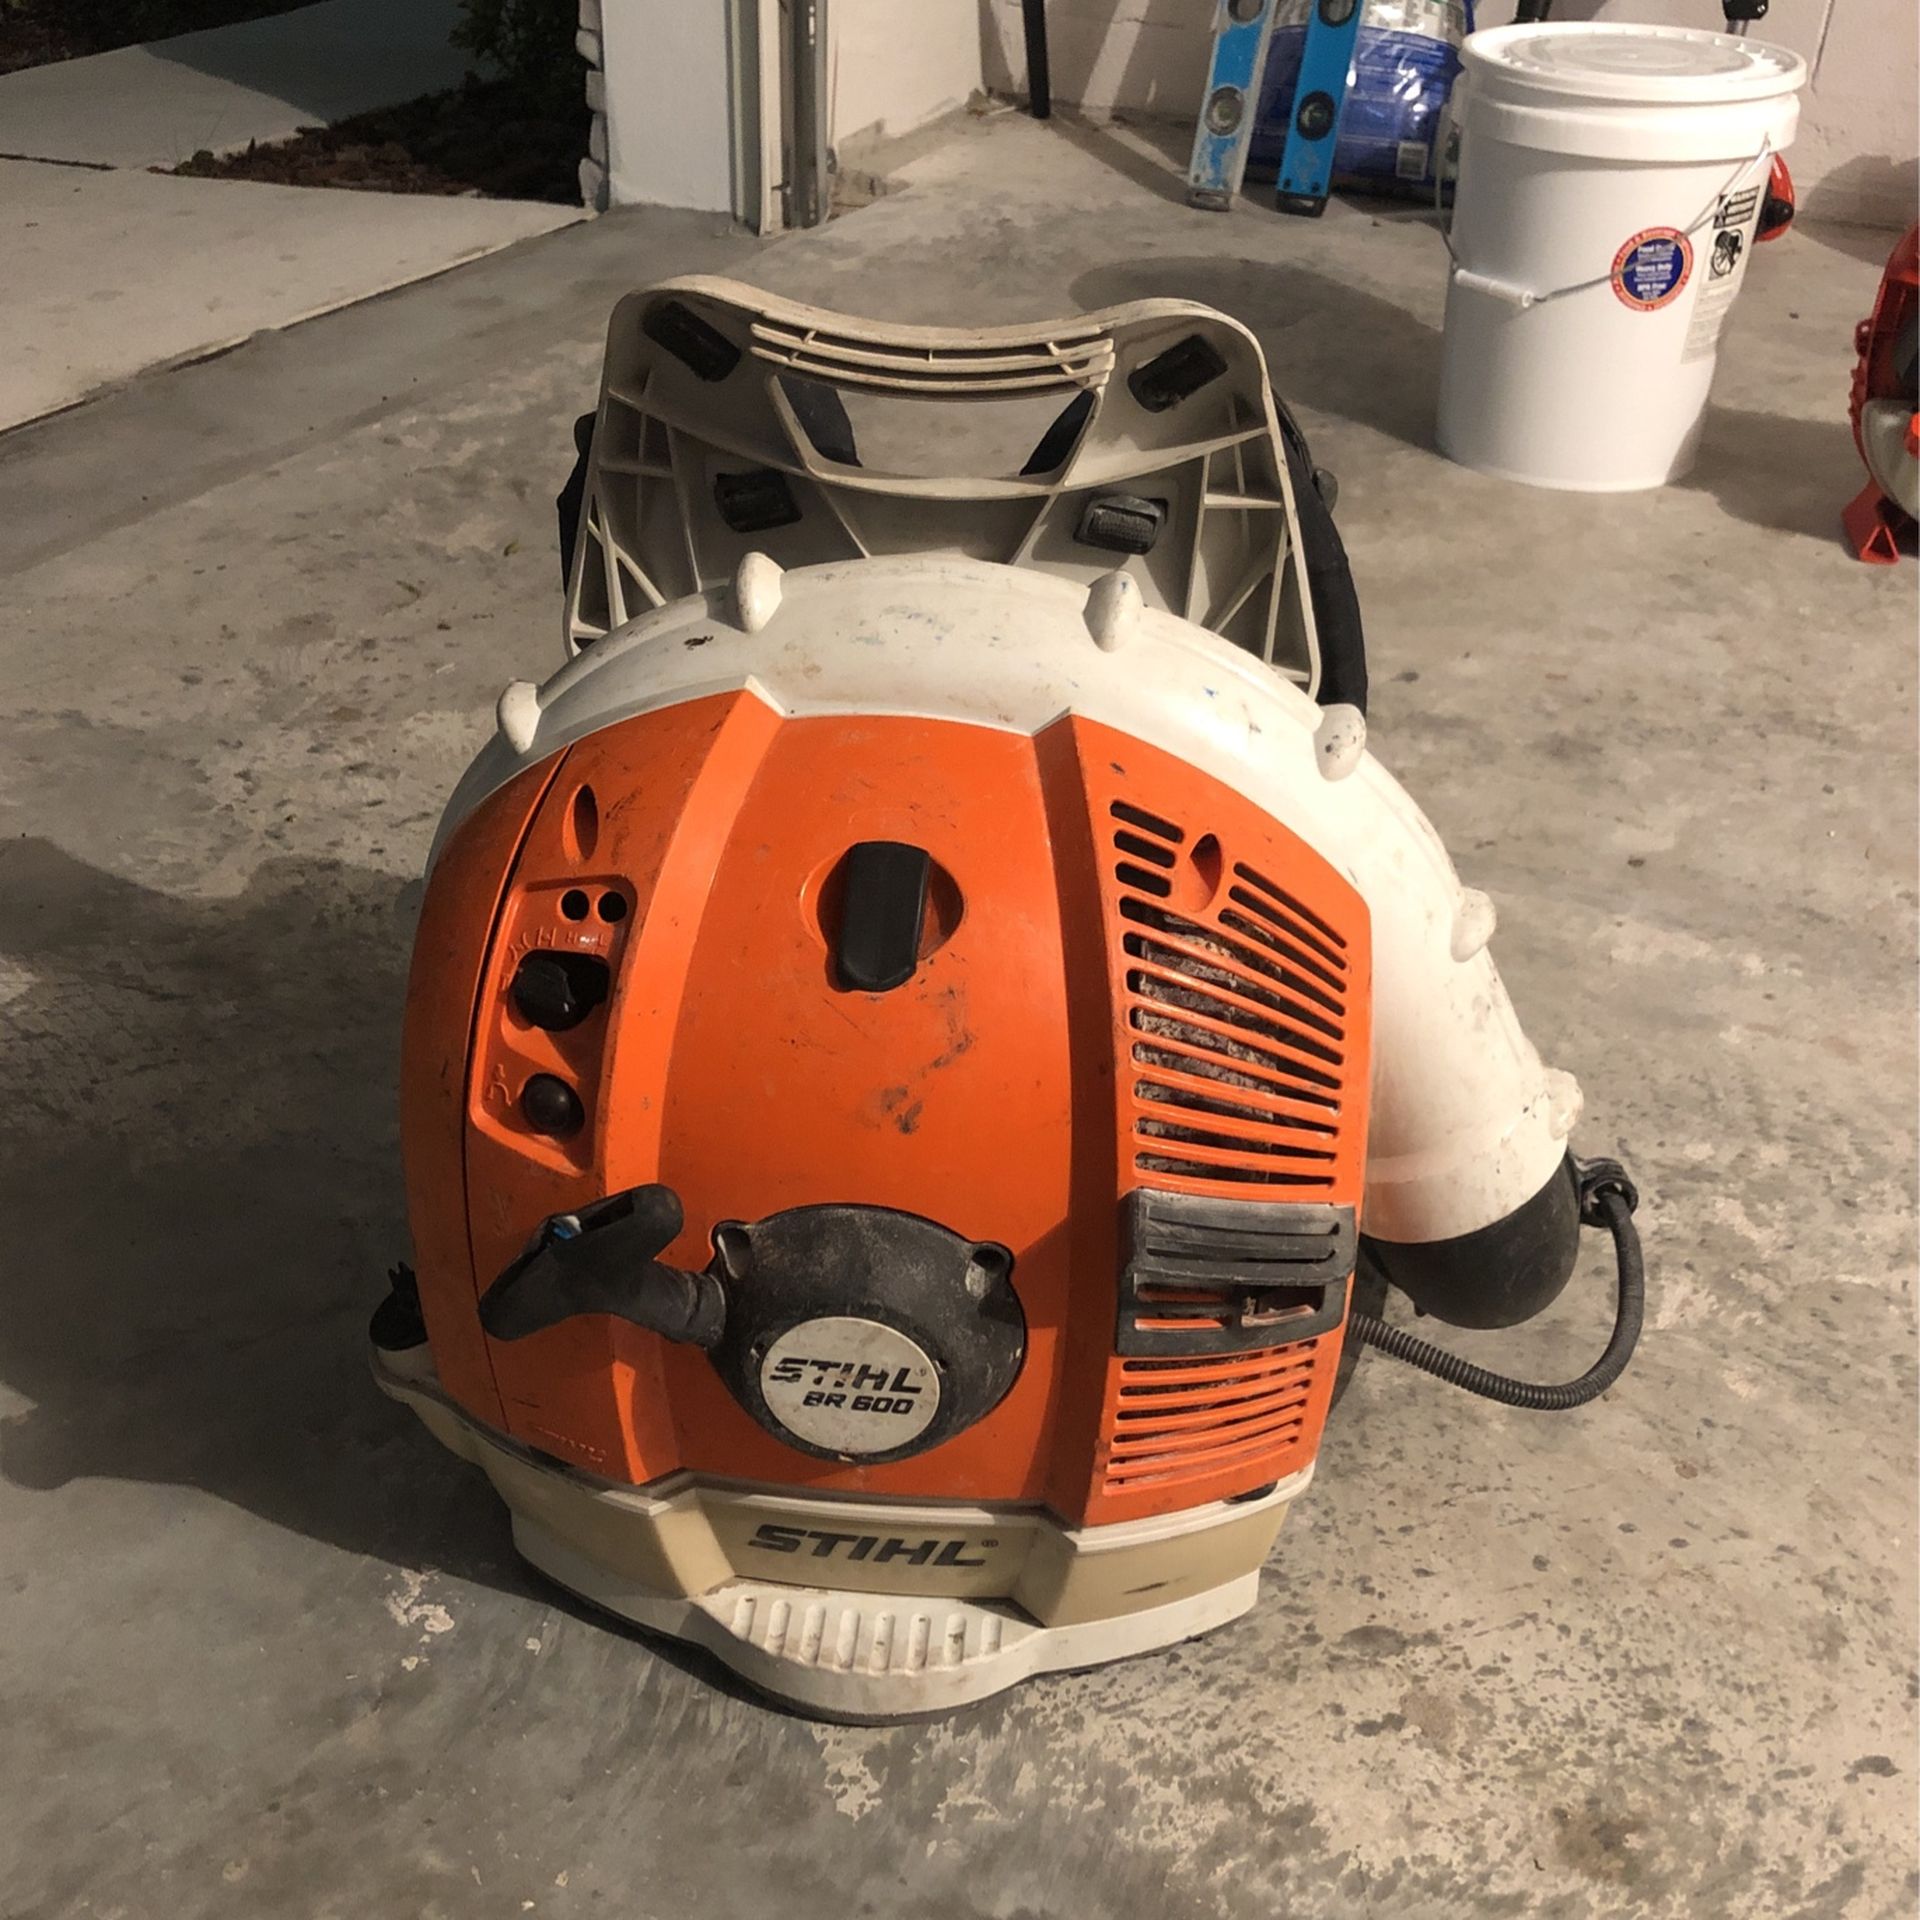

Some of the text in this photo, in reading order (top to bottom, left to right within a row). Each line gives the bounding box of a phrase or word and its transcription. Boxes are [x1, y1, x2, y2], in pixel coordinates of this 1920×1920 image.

[769, 1357, 923, 1394] STIHL
[802, 1391, 916, 1414] BR 600
[748, 1524, 987, 1567] STIHL
